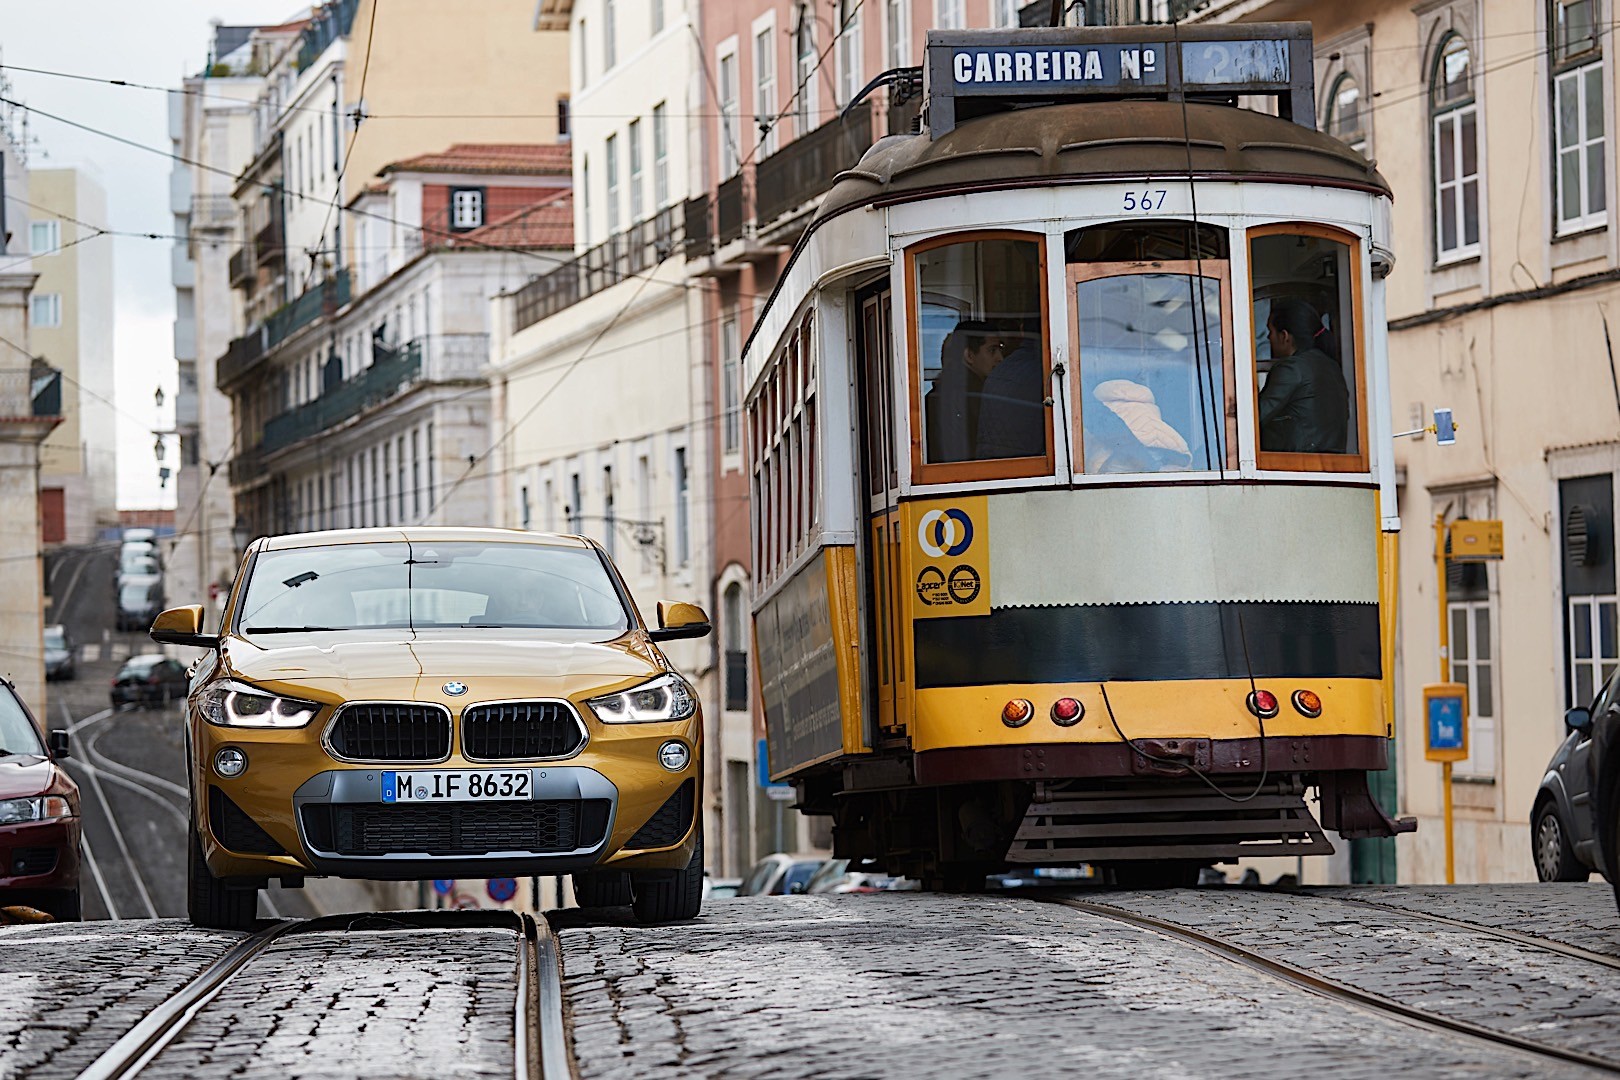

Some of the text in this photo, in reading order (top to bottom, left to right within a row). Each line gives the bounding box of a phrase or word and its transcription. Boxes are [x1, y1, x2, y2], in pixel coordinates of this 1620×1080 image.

[953, 49, 1104, 84] CARREIRA
[1123, 189, 1168, 211] 567
[386, 789, 393, 797] D
[397, 773, 529, 799] M IF 8632
